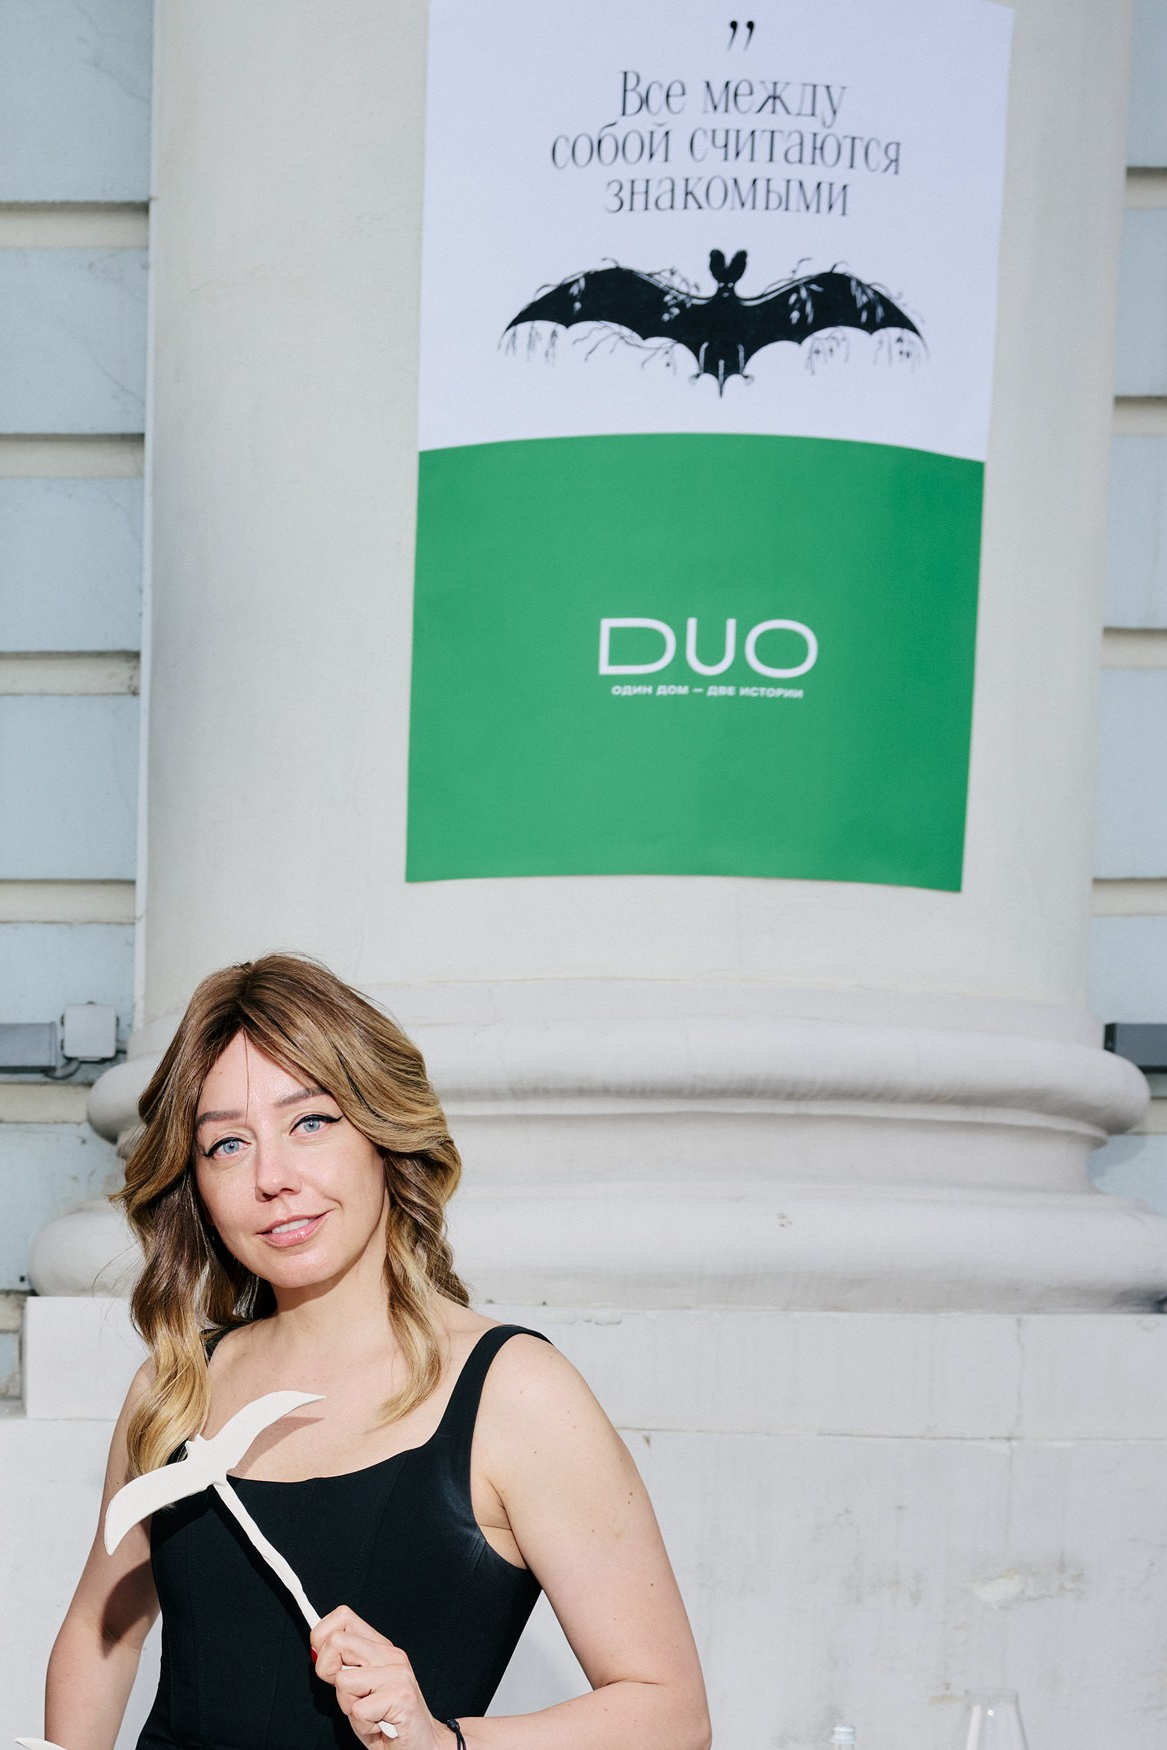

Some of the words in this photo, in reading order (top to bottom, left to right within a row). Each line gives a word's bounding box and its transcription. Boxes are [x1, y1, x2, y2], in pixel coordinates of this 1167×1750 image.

[619, 70, 688, 119] Все
[702, 79, 848, 128] между
[551, 120, 672, 170] собой
[688, 126, 902, 176] считаются
[605, 175, 849, 217] знакомыми
[598, 616, 819, 679] DUO
[611, 685, 653, 697] ОДИН
[656, 684, 690, 697] ДОМ
[707, 685, 736, 697] ДВЕ
[738, 686, 804, 699] ИСТОРИИ
